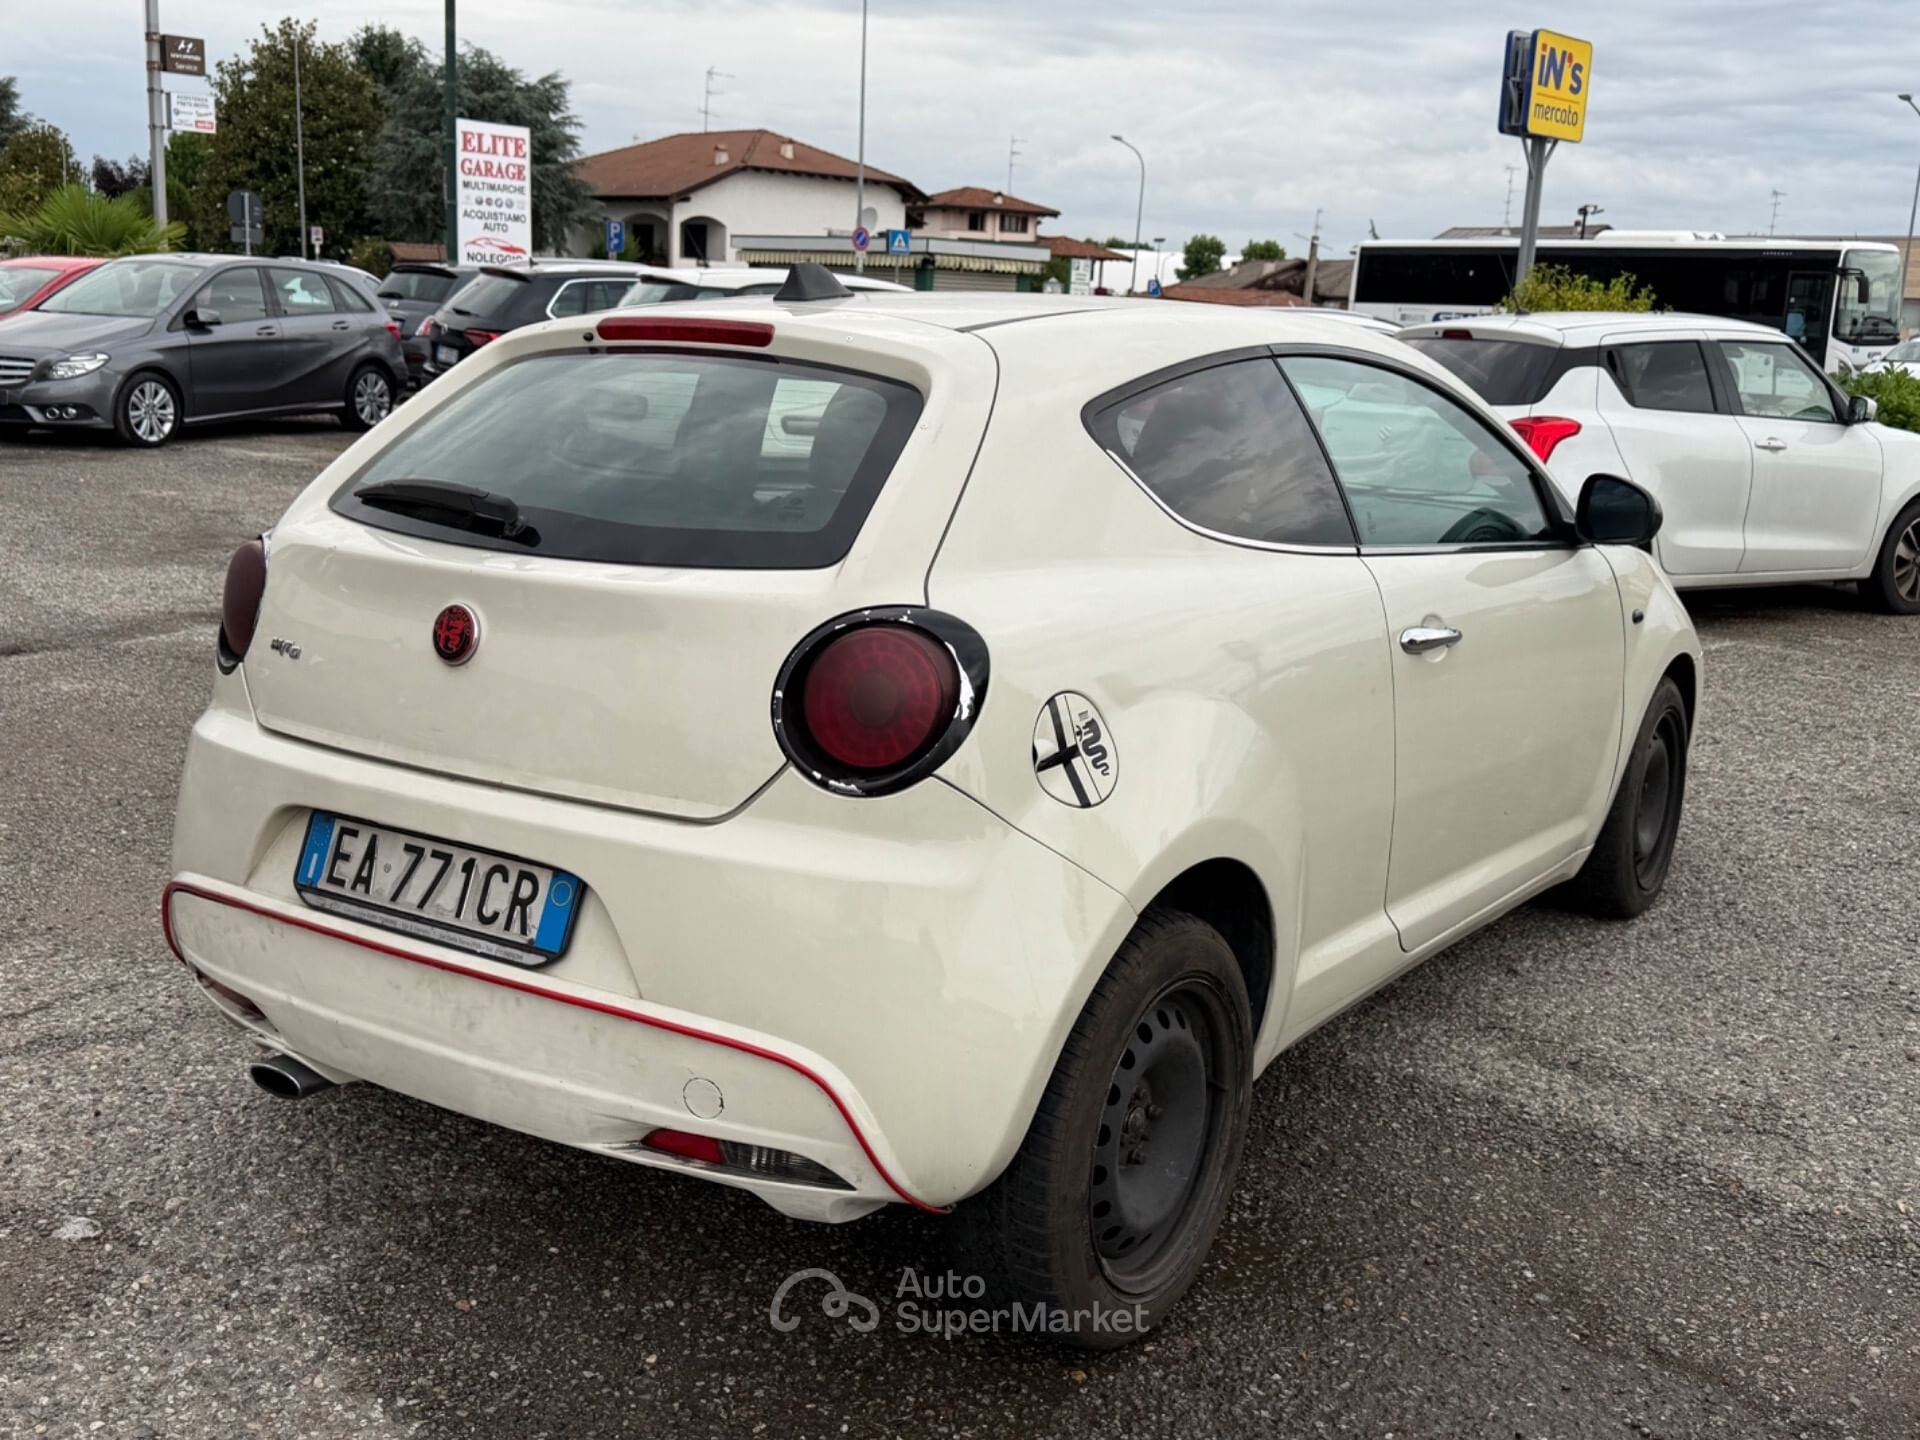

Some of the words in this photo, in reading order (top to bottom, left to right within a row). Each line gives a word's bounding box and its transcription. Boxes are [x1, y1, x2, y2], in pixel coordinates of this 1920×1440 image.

[1533, 103, 1579, 127] mercato
[461, 130, 527, 158] ELITE
[460, 158, 526, 181] GARAGE
[462, 180, 526, 195] MULTIMARCHE
[463, 209, 527, 224] ACQUISTIAMO
[483, 222, 509, 233] AUTO
[610, 222, 621, 239] P
[325, 826, 378, 895] EA
[389, 843, 540, 937] 771CR
